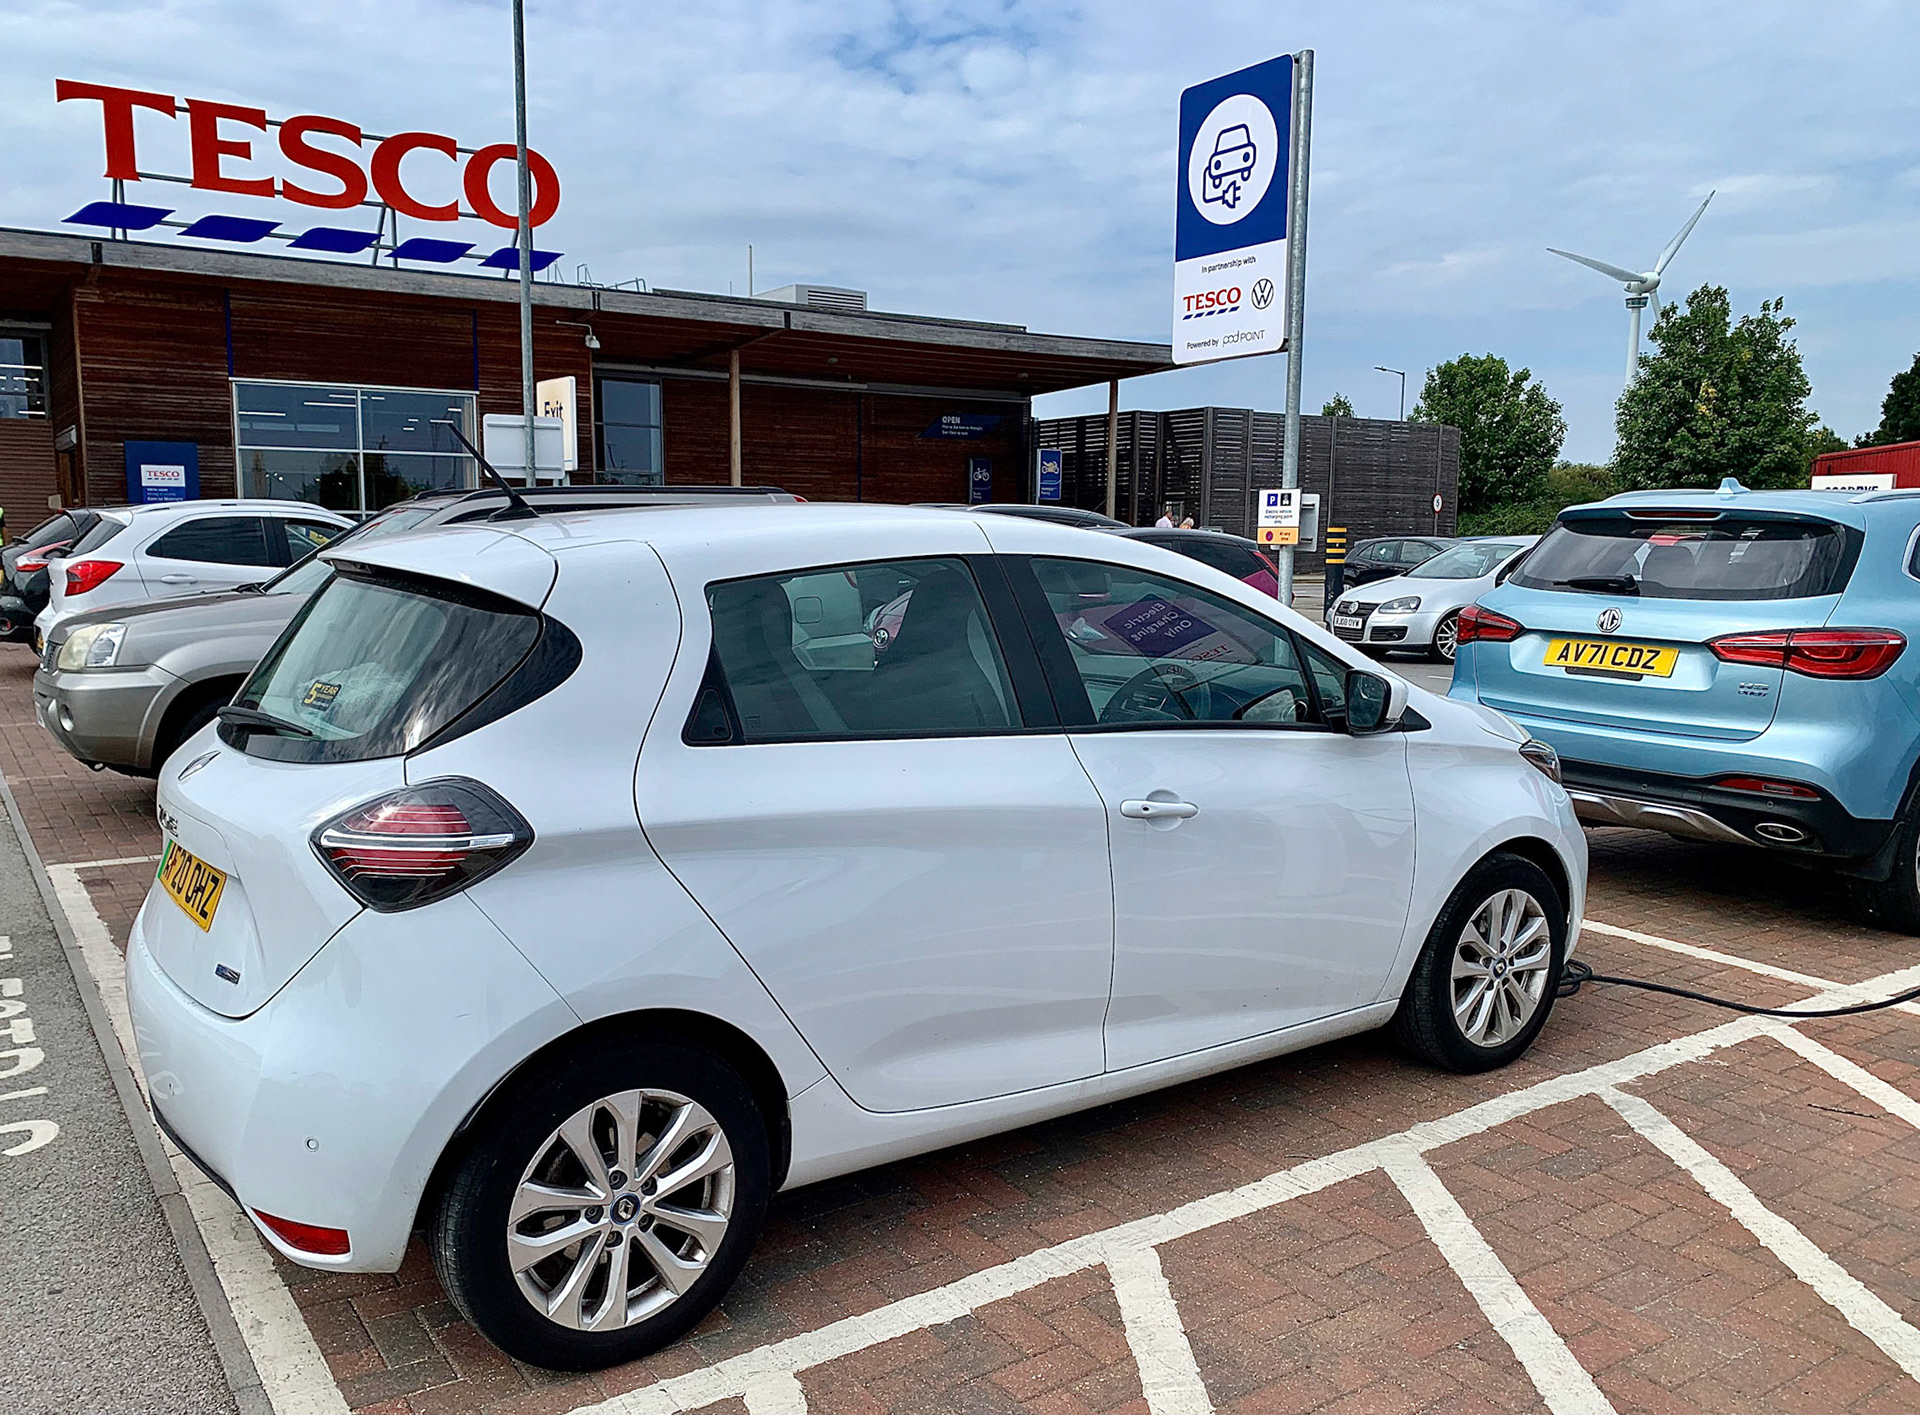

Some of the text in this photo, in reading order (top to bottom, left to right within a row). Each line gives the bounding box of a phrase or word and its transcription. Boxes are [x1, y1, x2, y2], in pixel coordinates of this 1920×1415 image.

[56, 79, 560, 229] TESCO
[1208, 259, 1242, 273] partnership
[1243, 256, 1257, 264] with
[1183, 287, 1242, 312] TESCO
[1187, 340, 1211, 349] Powered
[1212, 338, 1220, 348] by
[942, 416, 961, 424] OPEN
[146, 470, 180, 478] TESCO
[1597, 608, 1621, 632] MG
[1557, 642, 1661, 670] AV71 CDZ
[304, 683, 322, 704] 5
[321, 684, 339, 695] YEAR
